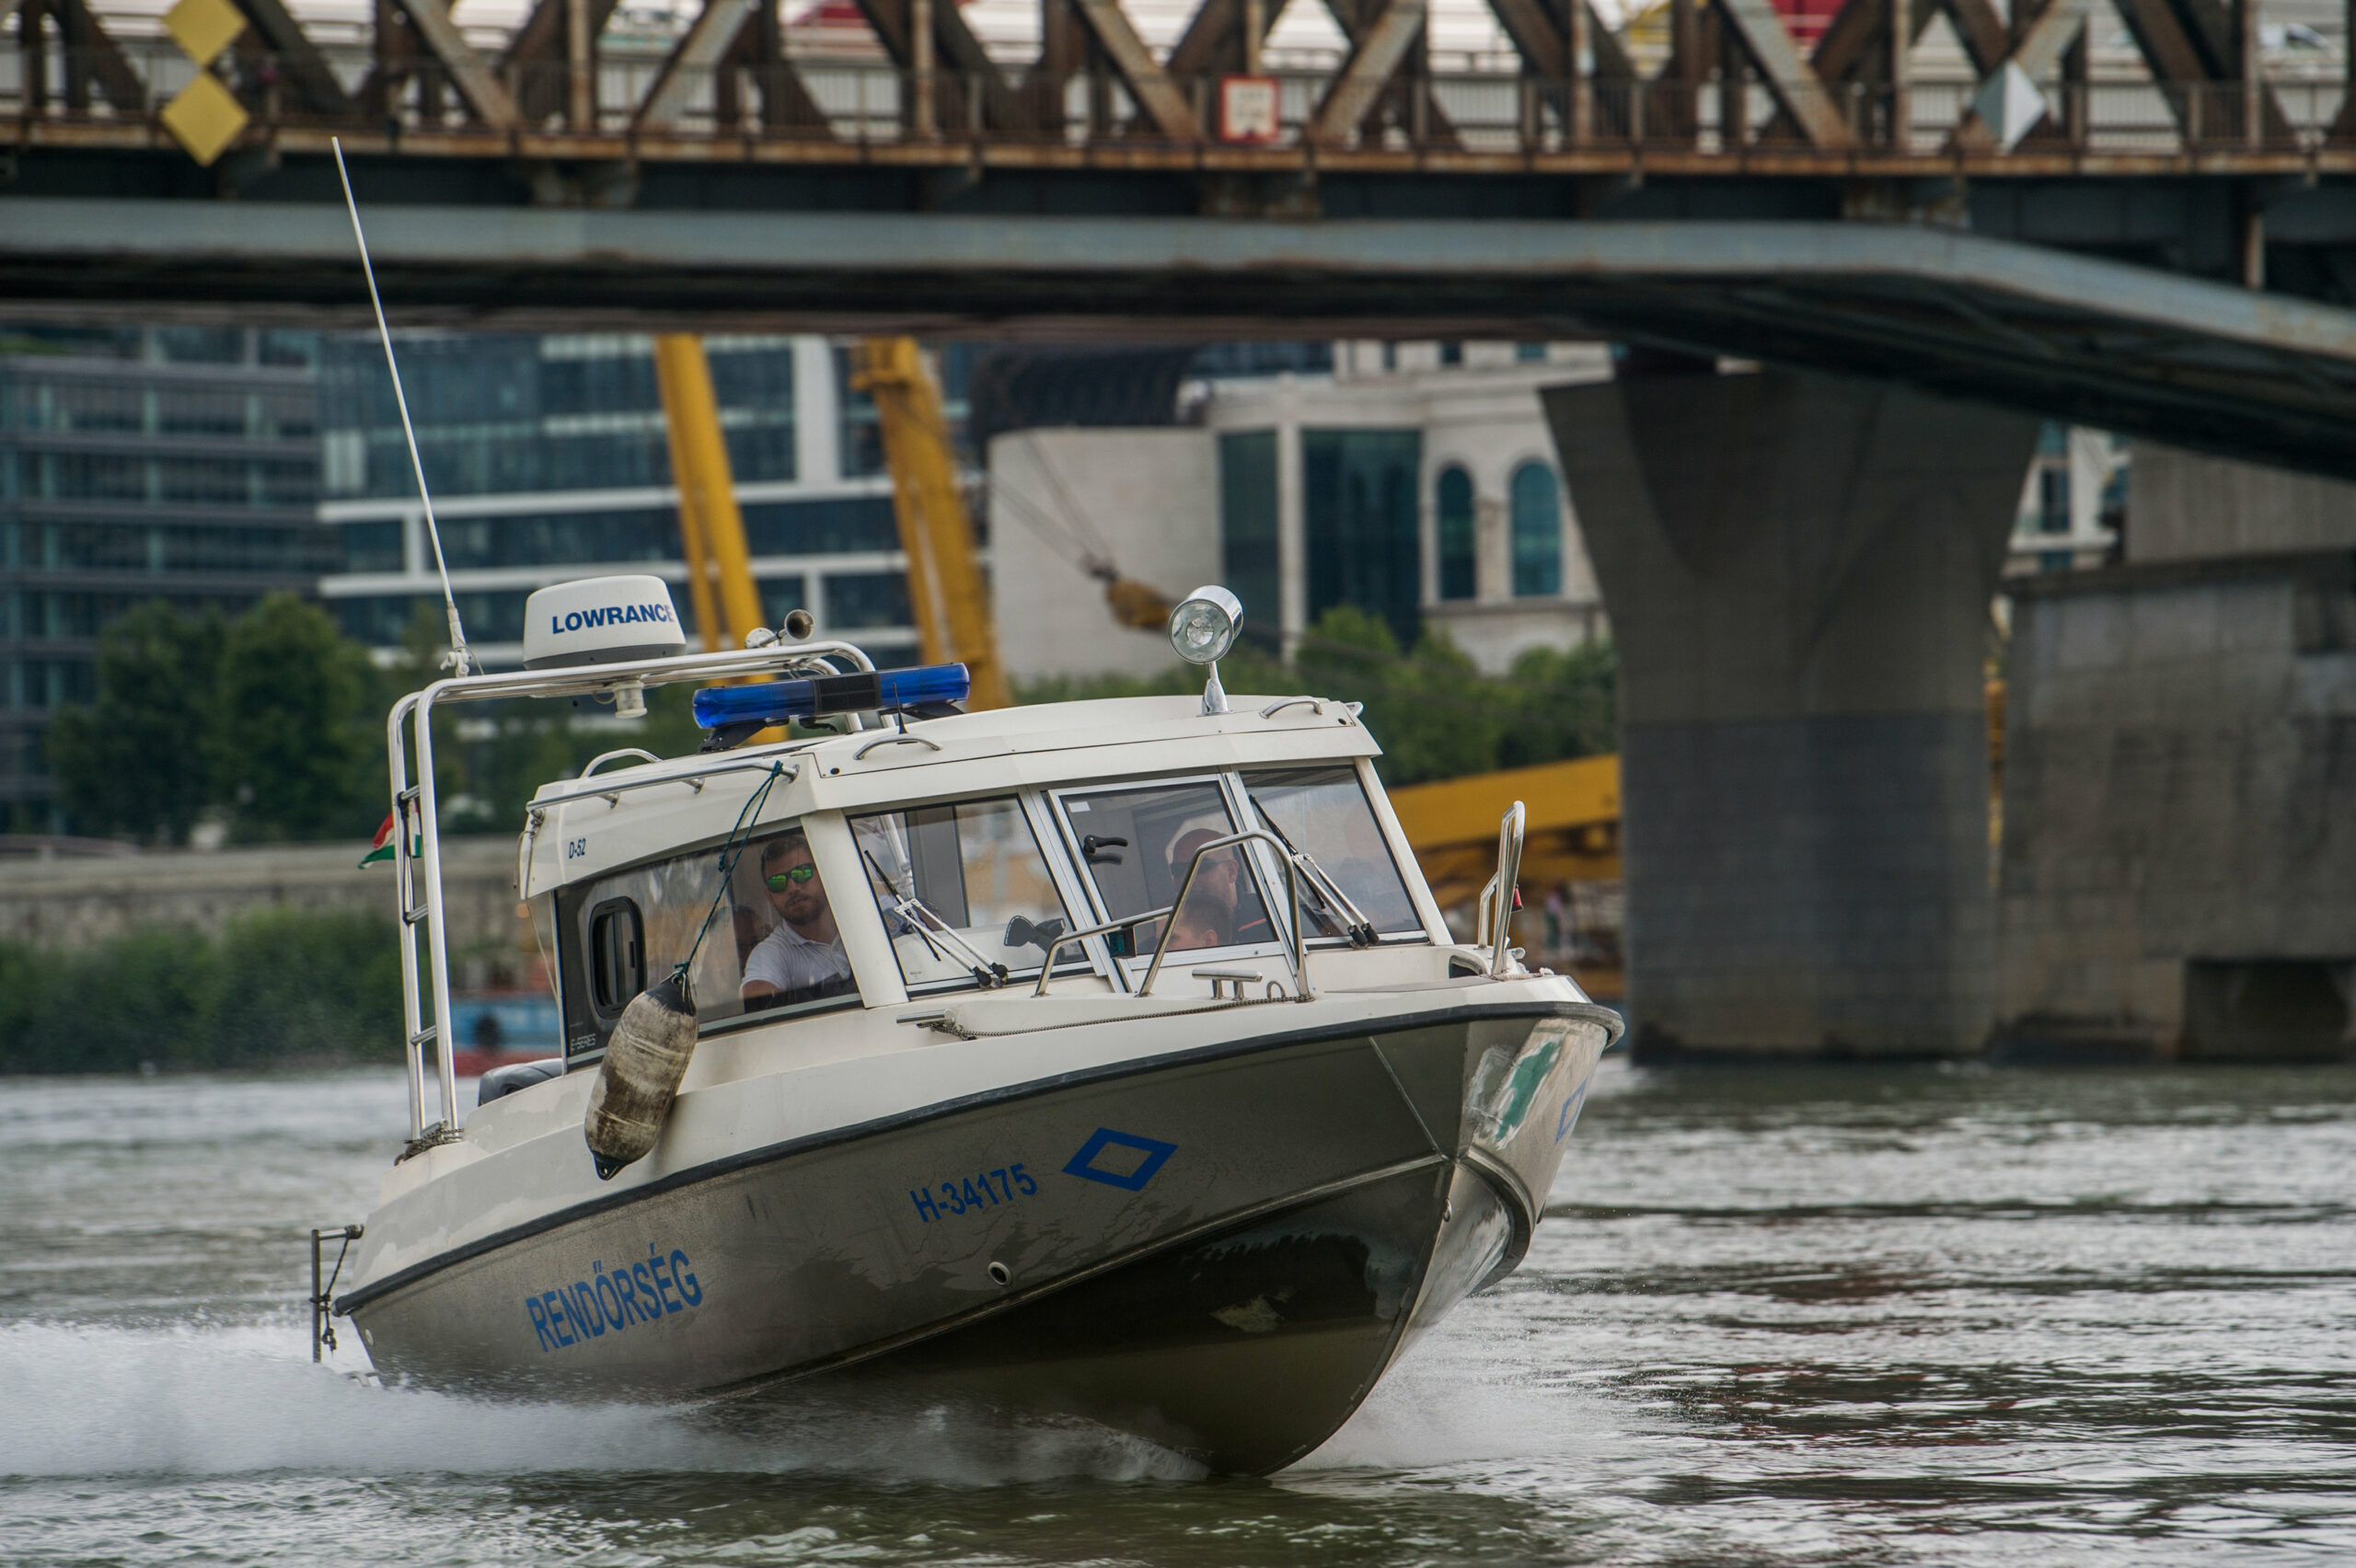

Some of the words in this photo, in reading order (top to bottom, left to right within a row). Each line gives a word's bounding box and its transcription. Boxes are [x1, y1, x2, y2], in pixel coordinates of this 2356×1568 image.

[552, 604, 675, 634] LOWRANCE
[568, 837, 586, 859] D-52
[909, 1162, 1038, 1223] H-34175
[525, 1242, 703, 1353] RENDŐRSÉG
